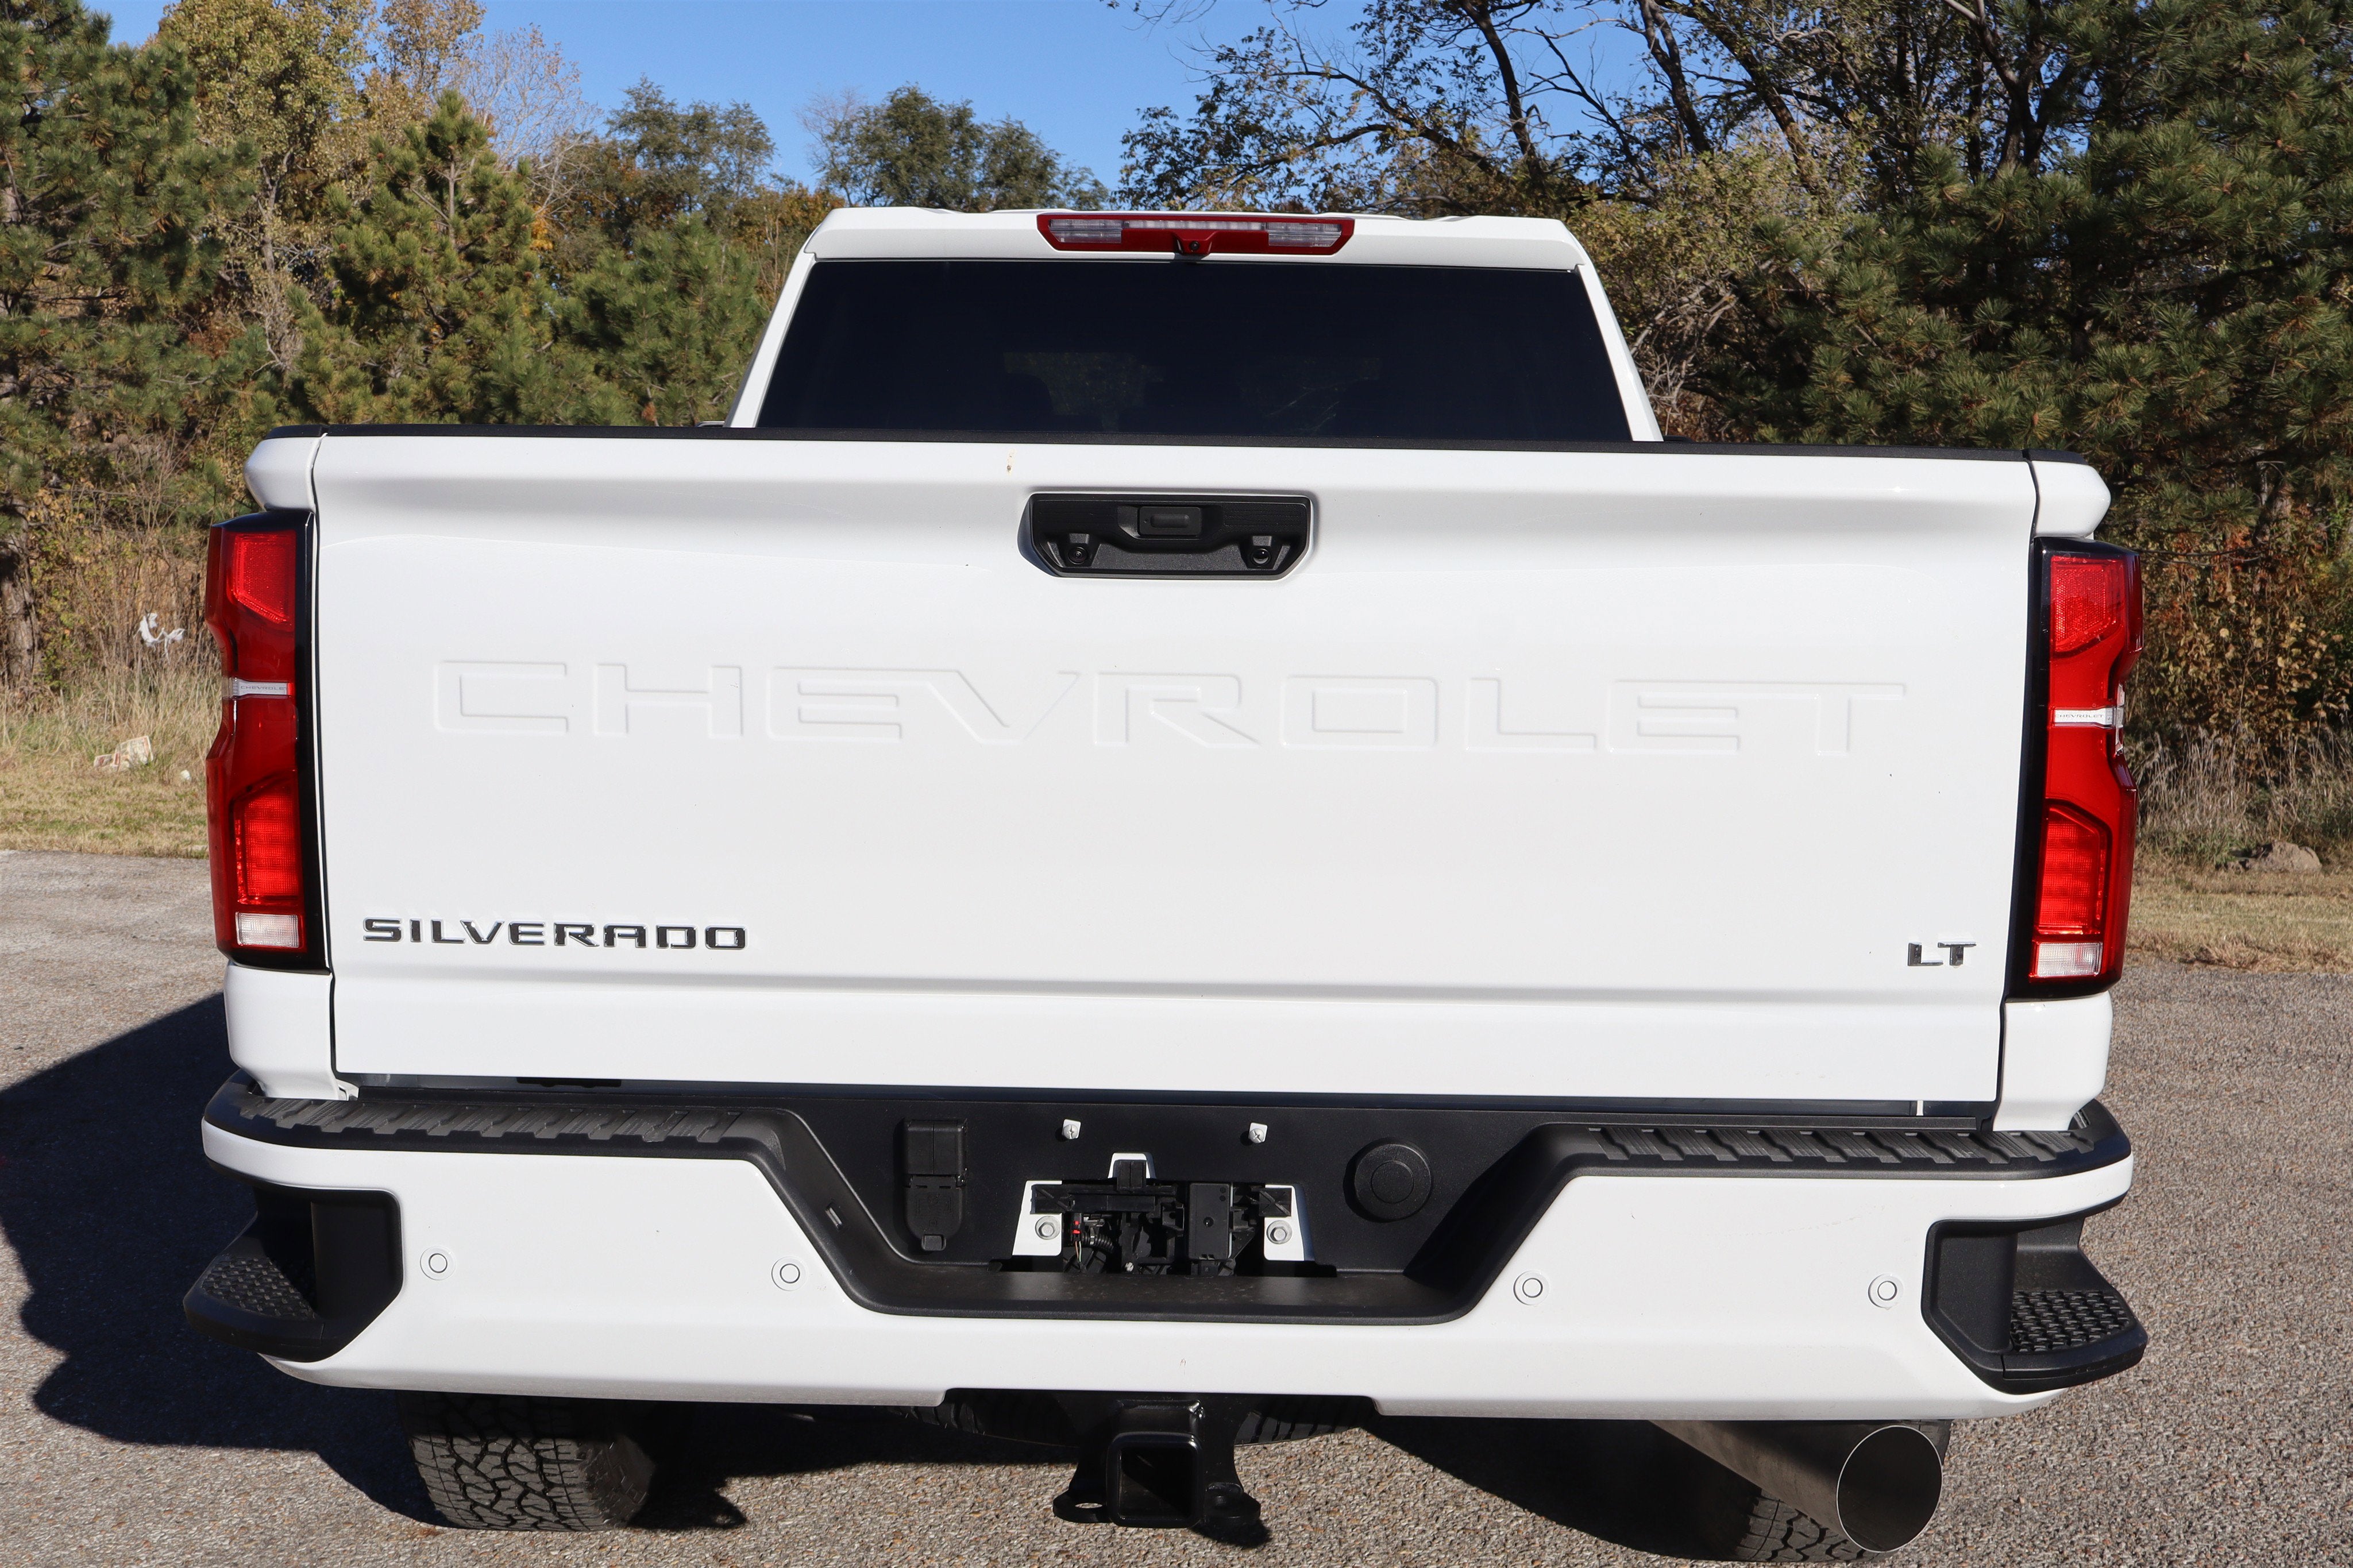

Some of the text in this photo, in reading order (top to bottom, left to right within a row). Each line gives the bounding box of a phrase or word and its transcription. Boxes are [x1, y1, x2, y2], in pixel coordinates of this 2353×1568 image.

[433, 660, 1907, 755] CHEVROLET
[363, 916, 748, 950] SILVERADO
[1907, 941, 1977, 967] LT
